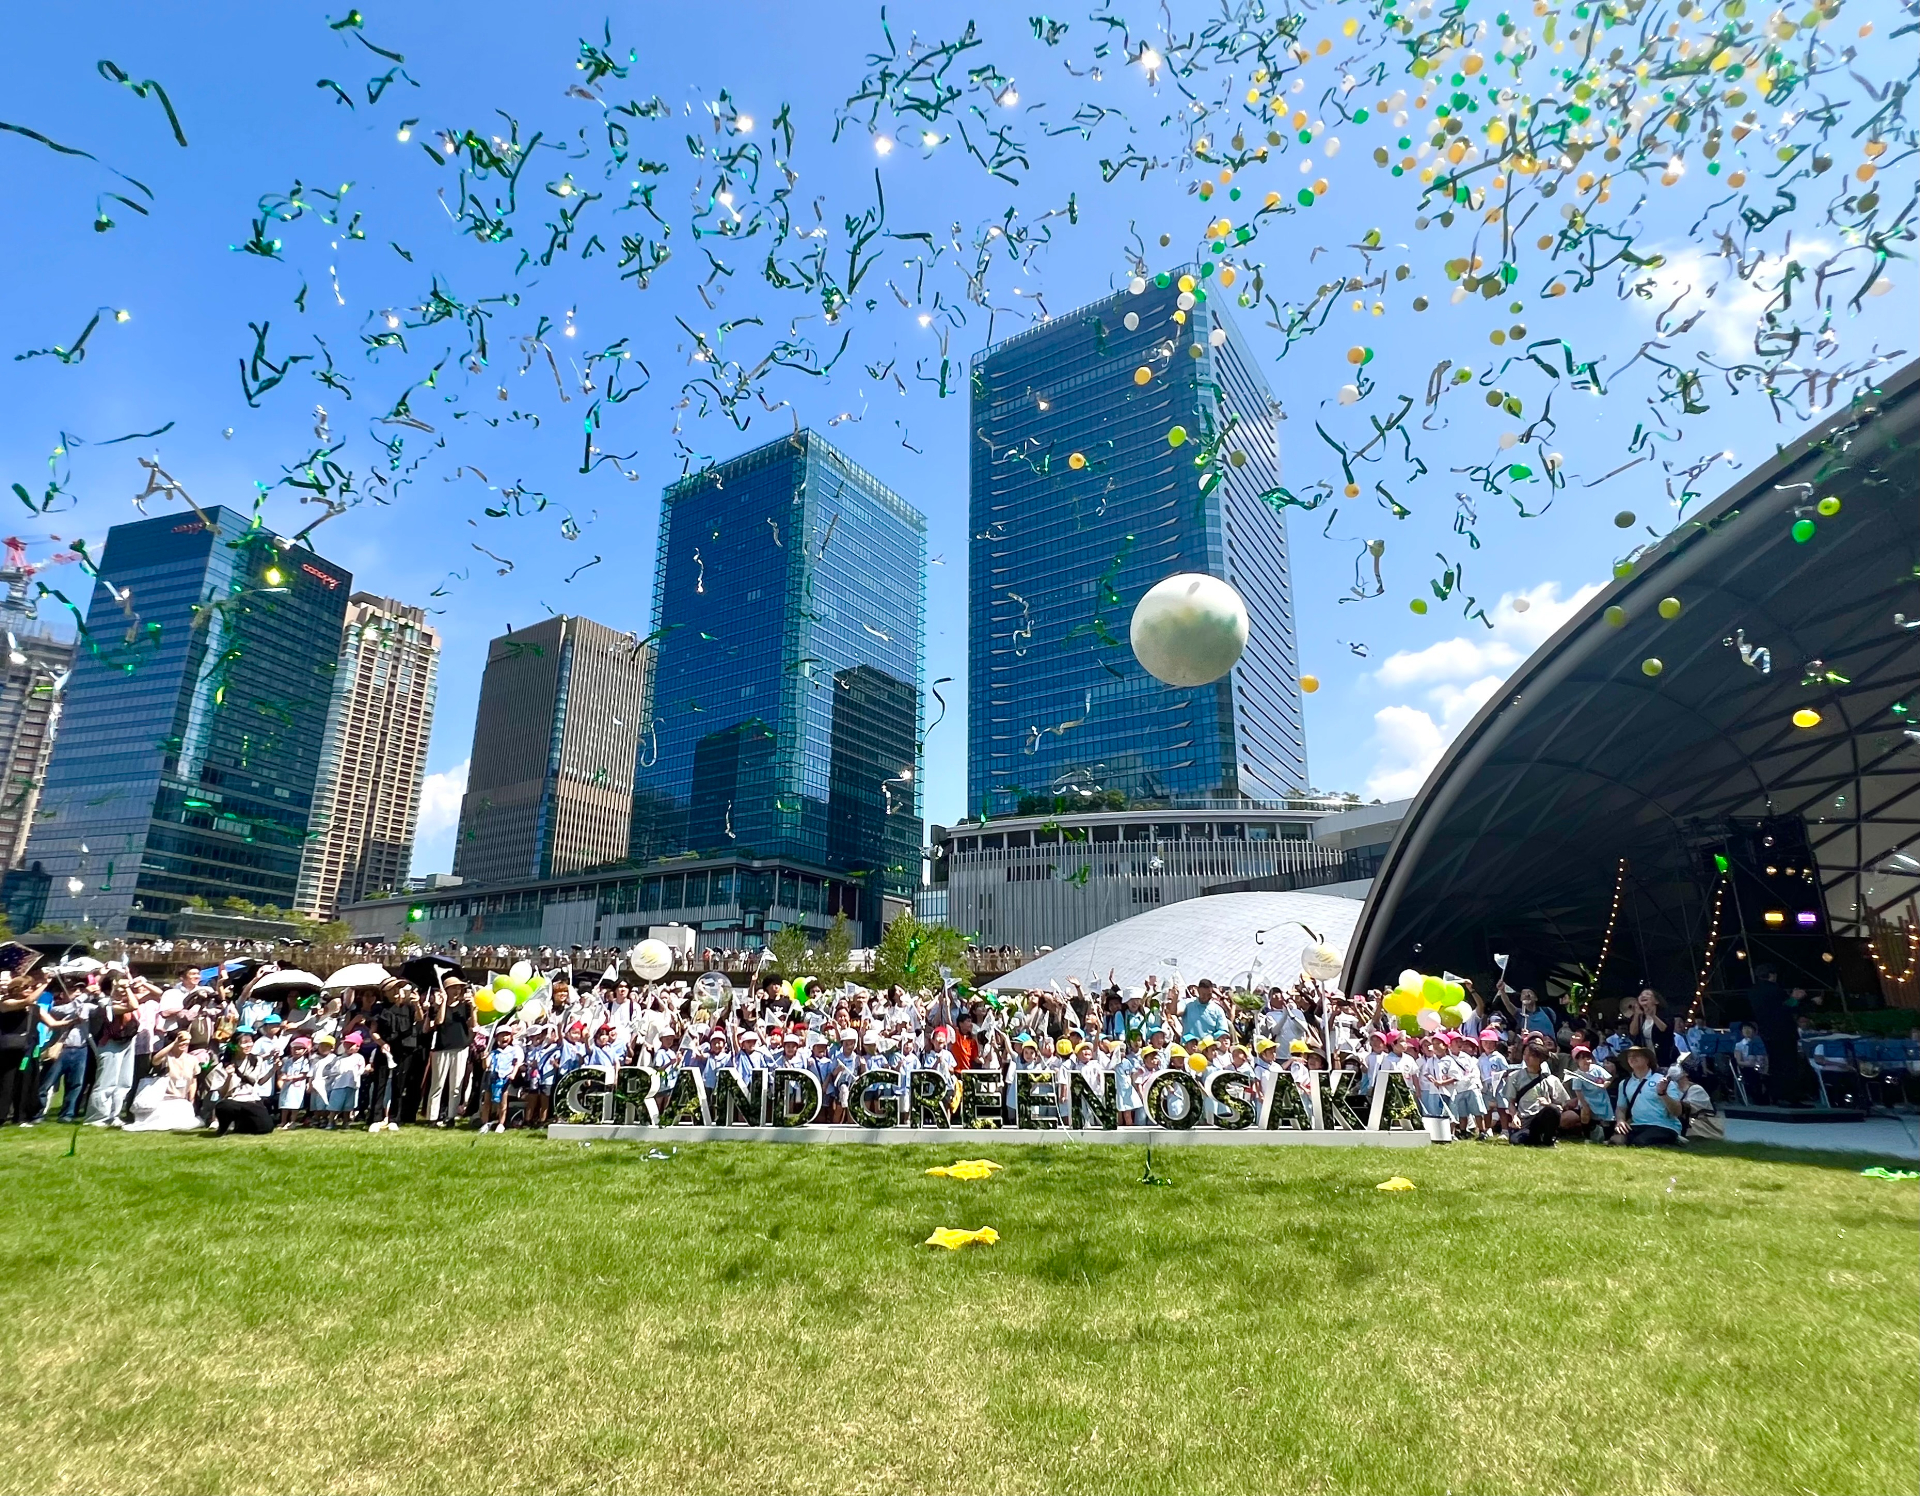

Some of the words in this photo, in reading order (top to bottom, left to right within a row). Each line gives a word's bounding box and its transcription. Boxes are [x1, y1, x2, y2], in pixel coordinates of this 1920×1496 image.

[301, 563, 342, 590] canopy
[553, 1066, 823, 1129] GRAND
[849, 1069, 1118, 1131] GREEN
[1144, 1069, 1426, 1132] OSAKA
